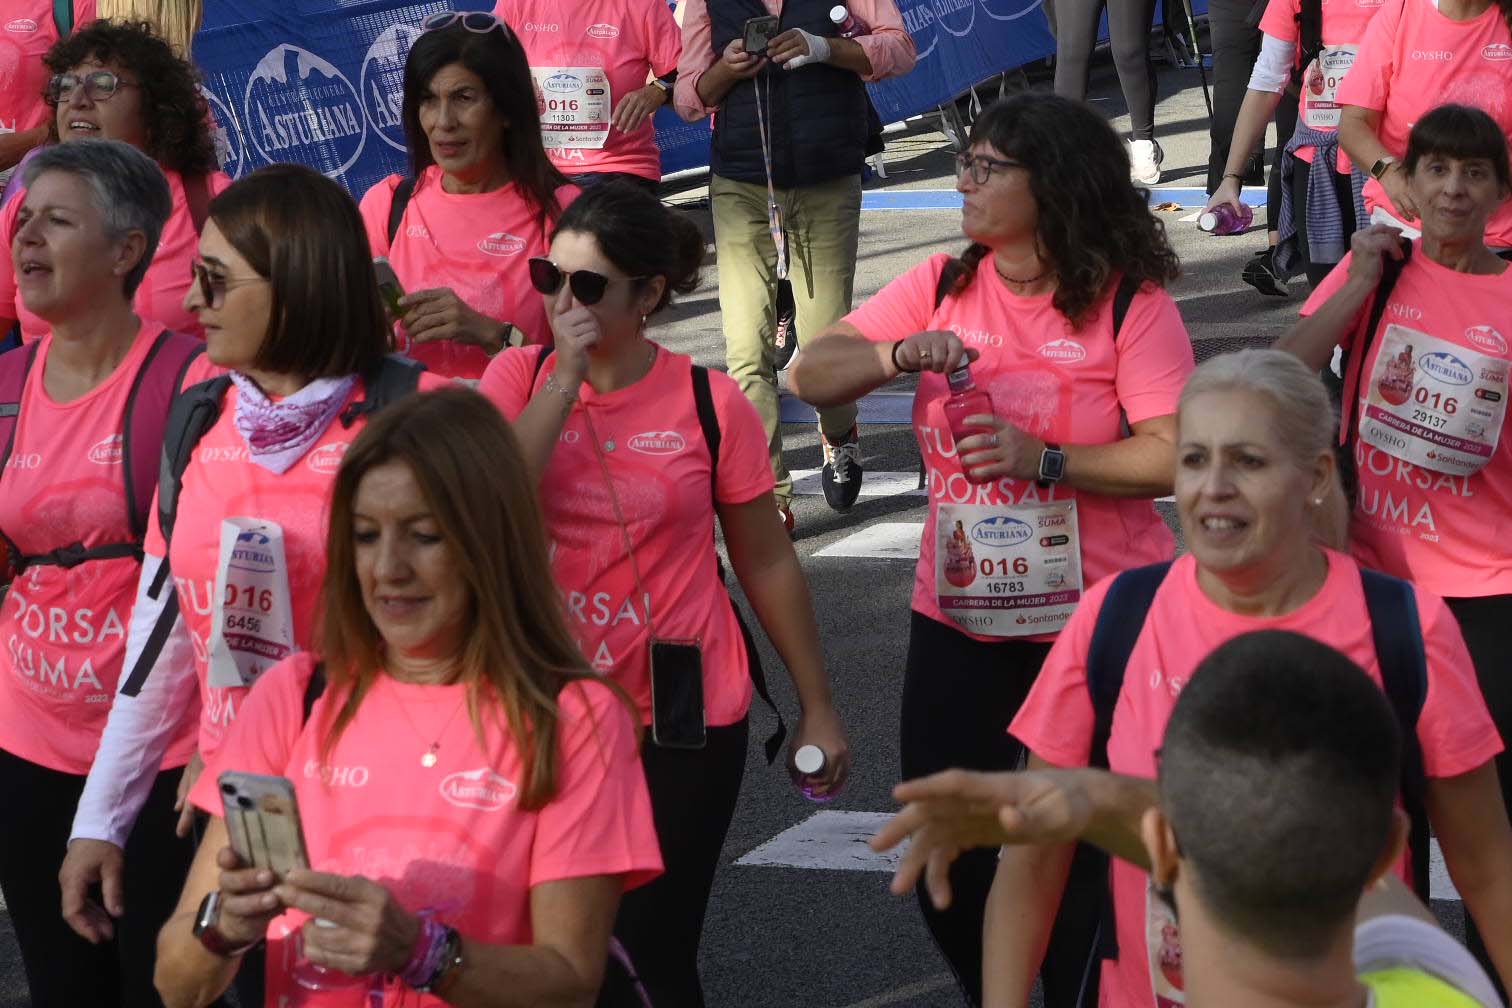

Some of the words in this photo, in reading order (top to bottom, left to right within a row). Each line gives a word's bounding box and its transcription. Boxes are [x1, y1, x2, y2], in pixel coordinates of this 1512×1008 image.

[1412, 49, 1453, 62] OYSHO
[548, 99, 579, 111] 016
[257, 99, 361, 152] ASTURIANA
[552, 114, 575, 122] 11303
[1424, 358, 1468, 383] ASTURIANA
[1414, 387, 1458, 415] 016
[1378, 412, 1411, 431] CARRERA
[1412, 409, 1448, 429] 29137
[632, 437, 682, 449] ASTURIANA
[1370, 427, 1406, 450] OYSHO
[1361, 486, 1436, 531] UMA
[1038, 519, 1066, 529] SUMA
[976, 528, 1029, 540] ASTURIANA
[980, 557, 1029, 577] 016
[986, 581, 1025, 593] 16783
[952, 598, 990, 607] CARRERA
[1004, 599, 1016, 607] LA
[1017, 596, 1046, 606] MUJER
